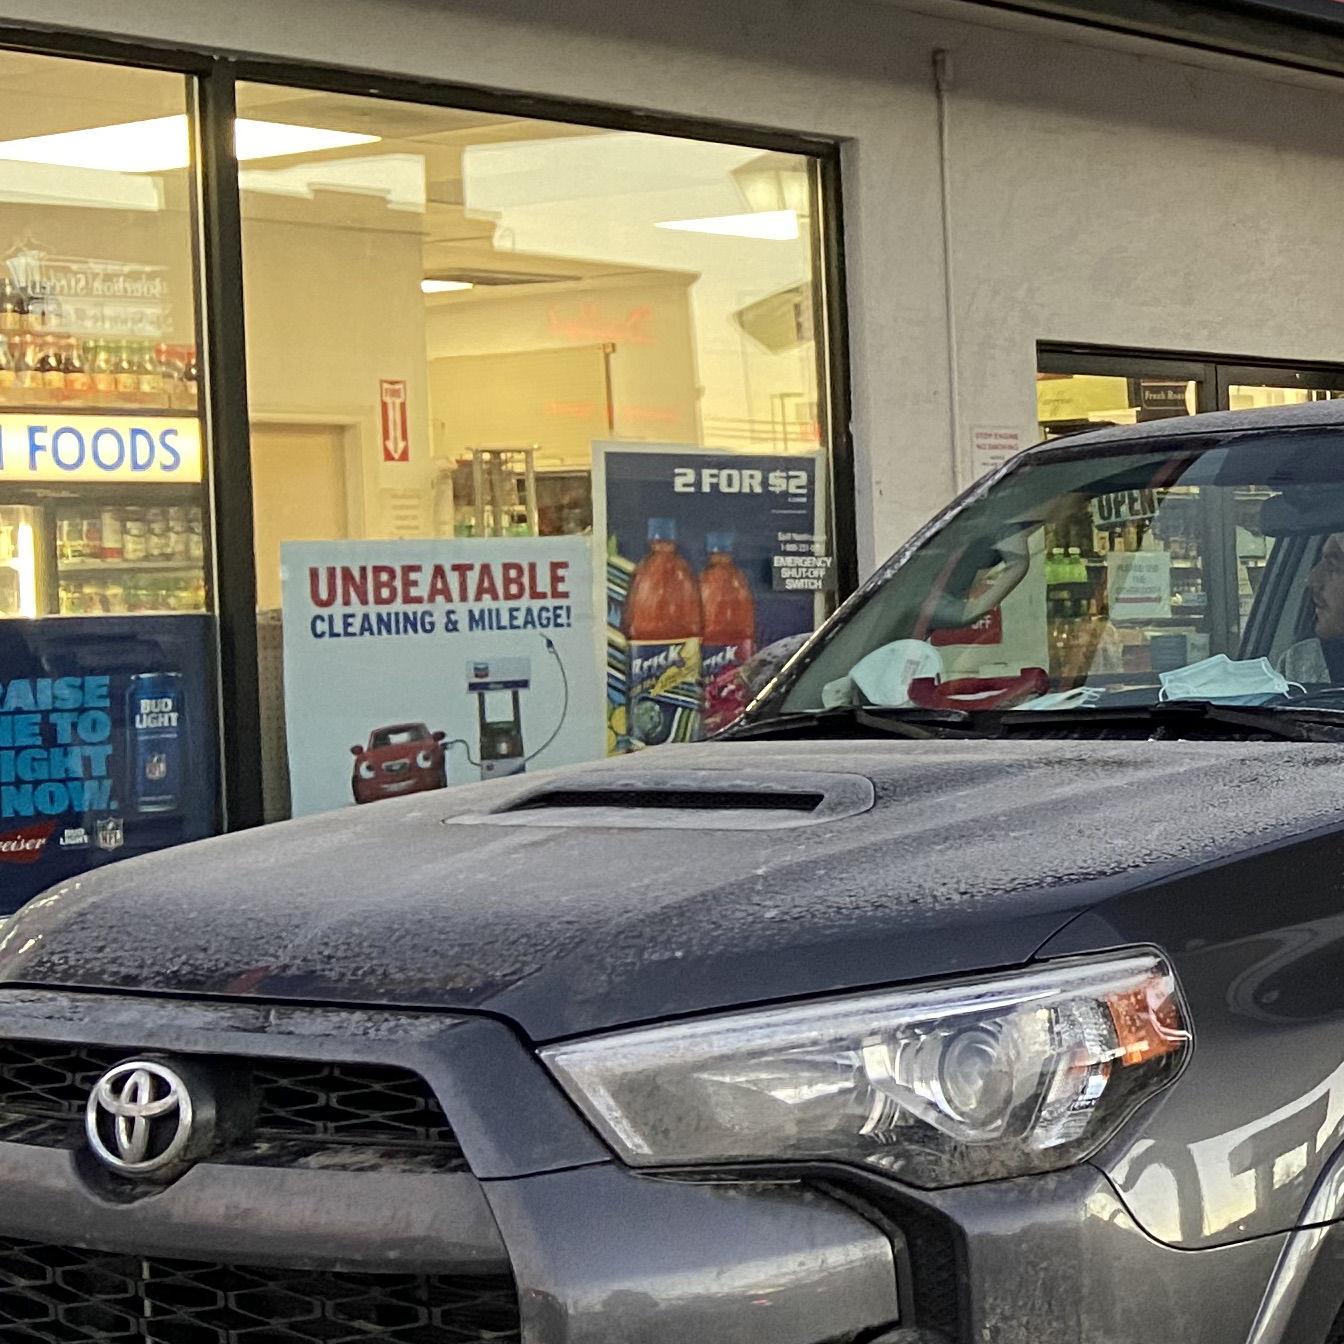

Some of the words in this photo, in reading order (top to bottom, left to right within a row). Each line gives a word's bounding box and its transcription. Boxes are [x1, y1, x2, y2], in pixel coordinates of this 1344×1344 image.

[27, 425, 181, 472] FOODS
[674, 468, 696, 493] 2
[701, 469, 763, 494] FOR
[768, 470, 808, 494] $2
[773, 556, 832, 567] EMERGENCY
[780, 567, 826, 579] SHUT-OFF
[308, 560, 571, 608] UNBEATABLE
[785, 578, 822, 590] SWITCH
[310, 610, 436, 639] CLEANING
[444, 609, 460, 633] &
[467, 605, 572, 632] MILEAGE!
[0, 675, 110, 713] AISE
[140, 698, 173, 714] BUD
[50, 710, 111, 744] TO
[135, 712, 178, 728] LIGHT
[0, 779, 120, 817] NOW.
[0, 834, 47, 852] eiser
